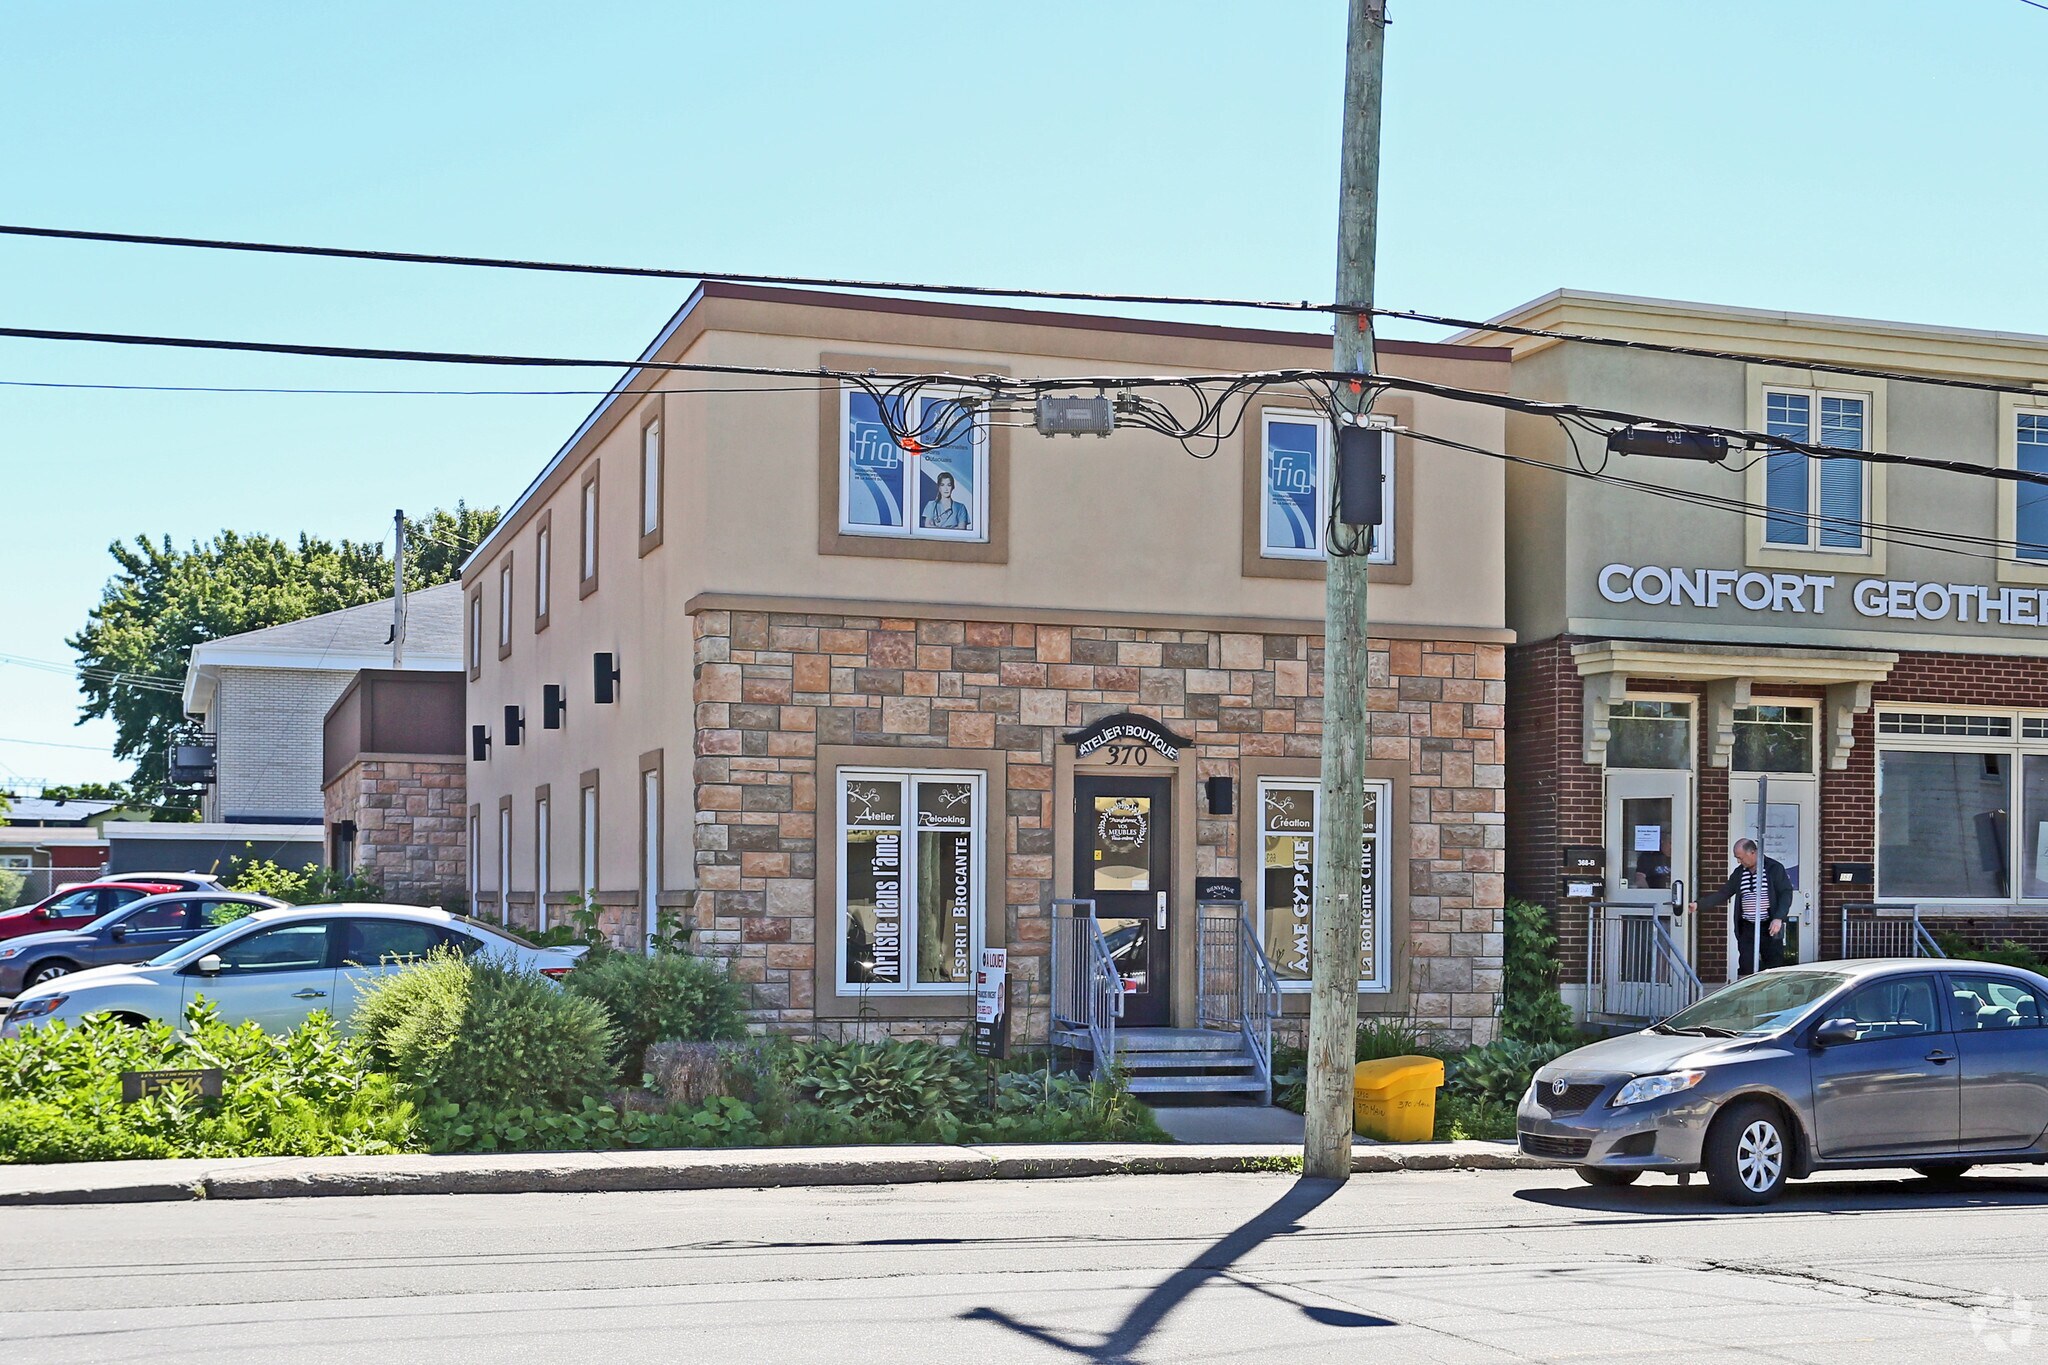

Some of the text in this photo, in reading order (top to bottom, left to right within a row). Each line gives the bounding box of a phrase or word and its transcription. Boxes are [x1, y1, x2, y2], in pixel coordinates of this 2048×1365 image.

[1598, 563, 1835, 614] CONFORT
[1106, 746, 1147, 766] 370
[854, 807, 895, 825] Atelier
[918, 811, 965, 827] Relooking
[1270, 814, 1310, 829] Création
[872, 881, 899, 918] dans
[1206, 885, 1235, 894] BIENVENUE
[952, 837, 968, 978] ESPRIT BROCANTE
[1287, 840, 1310, 974] ÂME GYPSIE
[872, 922, 899, 976] Artiste
[990, 953, 1004, 968] LOUER
